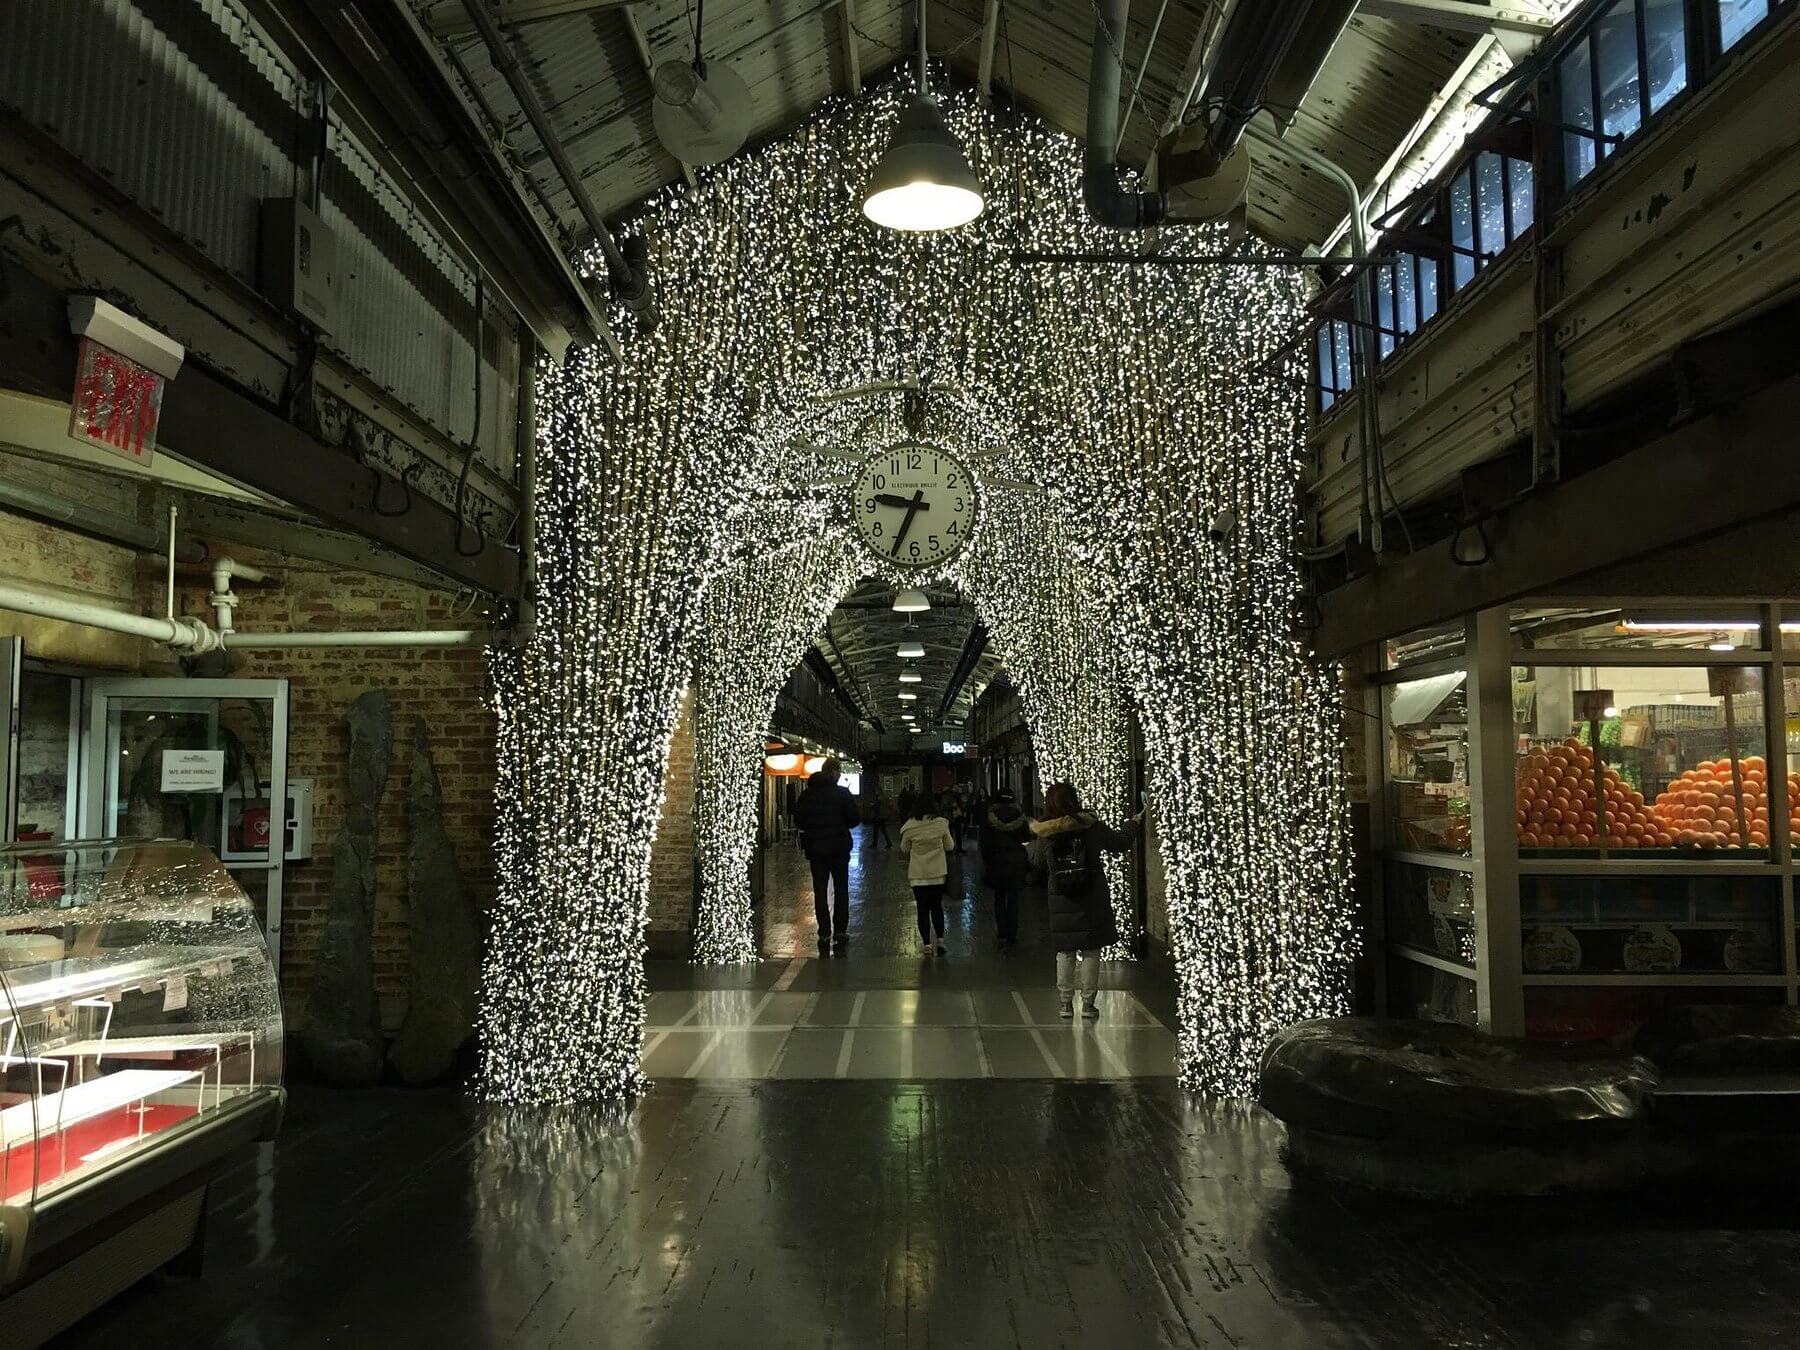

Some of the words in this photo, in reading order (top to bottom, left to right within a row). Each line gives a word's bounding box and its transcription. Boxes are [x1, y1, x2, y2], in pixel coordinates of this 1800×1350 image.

[891, 459, 900, 475] 11
[907, 454, 922, 470] 12
[934, 459, 938, 475] 1
[872, 474, 886, 490] 10
[946, 473, 957, 489] 2
[865, 498, 876, 513] 9
[953, 497, 964, 512] 3
[872, 522, 883, 537] 8
[946, 520, 958, 536] 4
[909, 541, 921, 557] 6
[928, 535, 940, 551] 5
